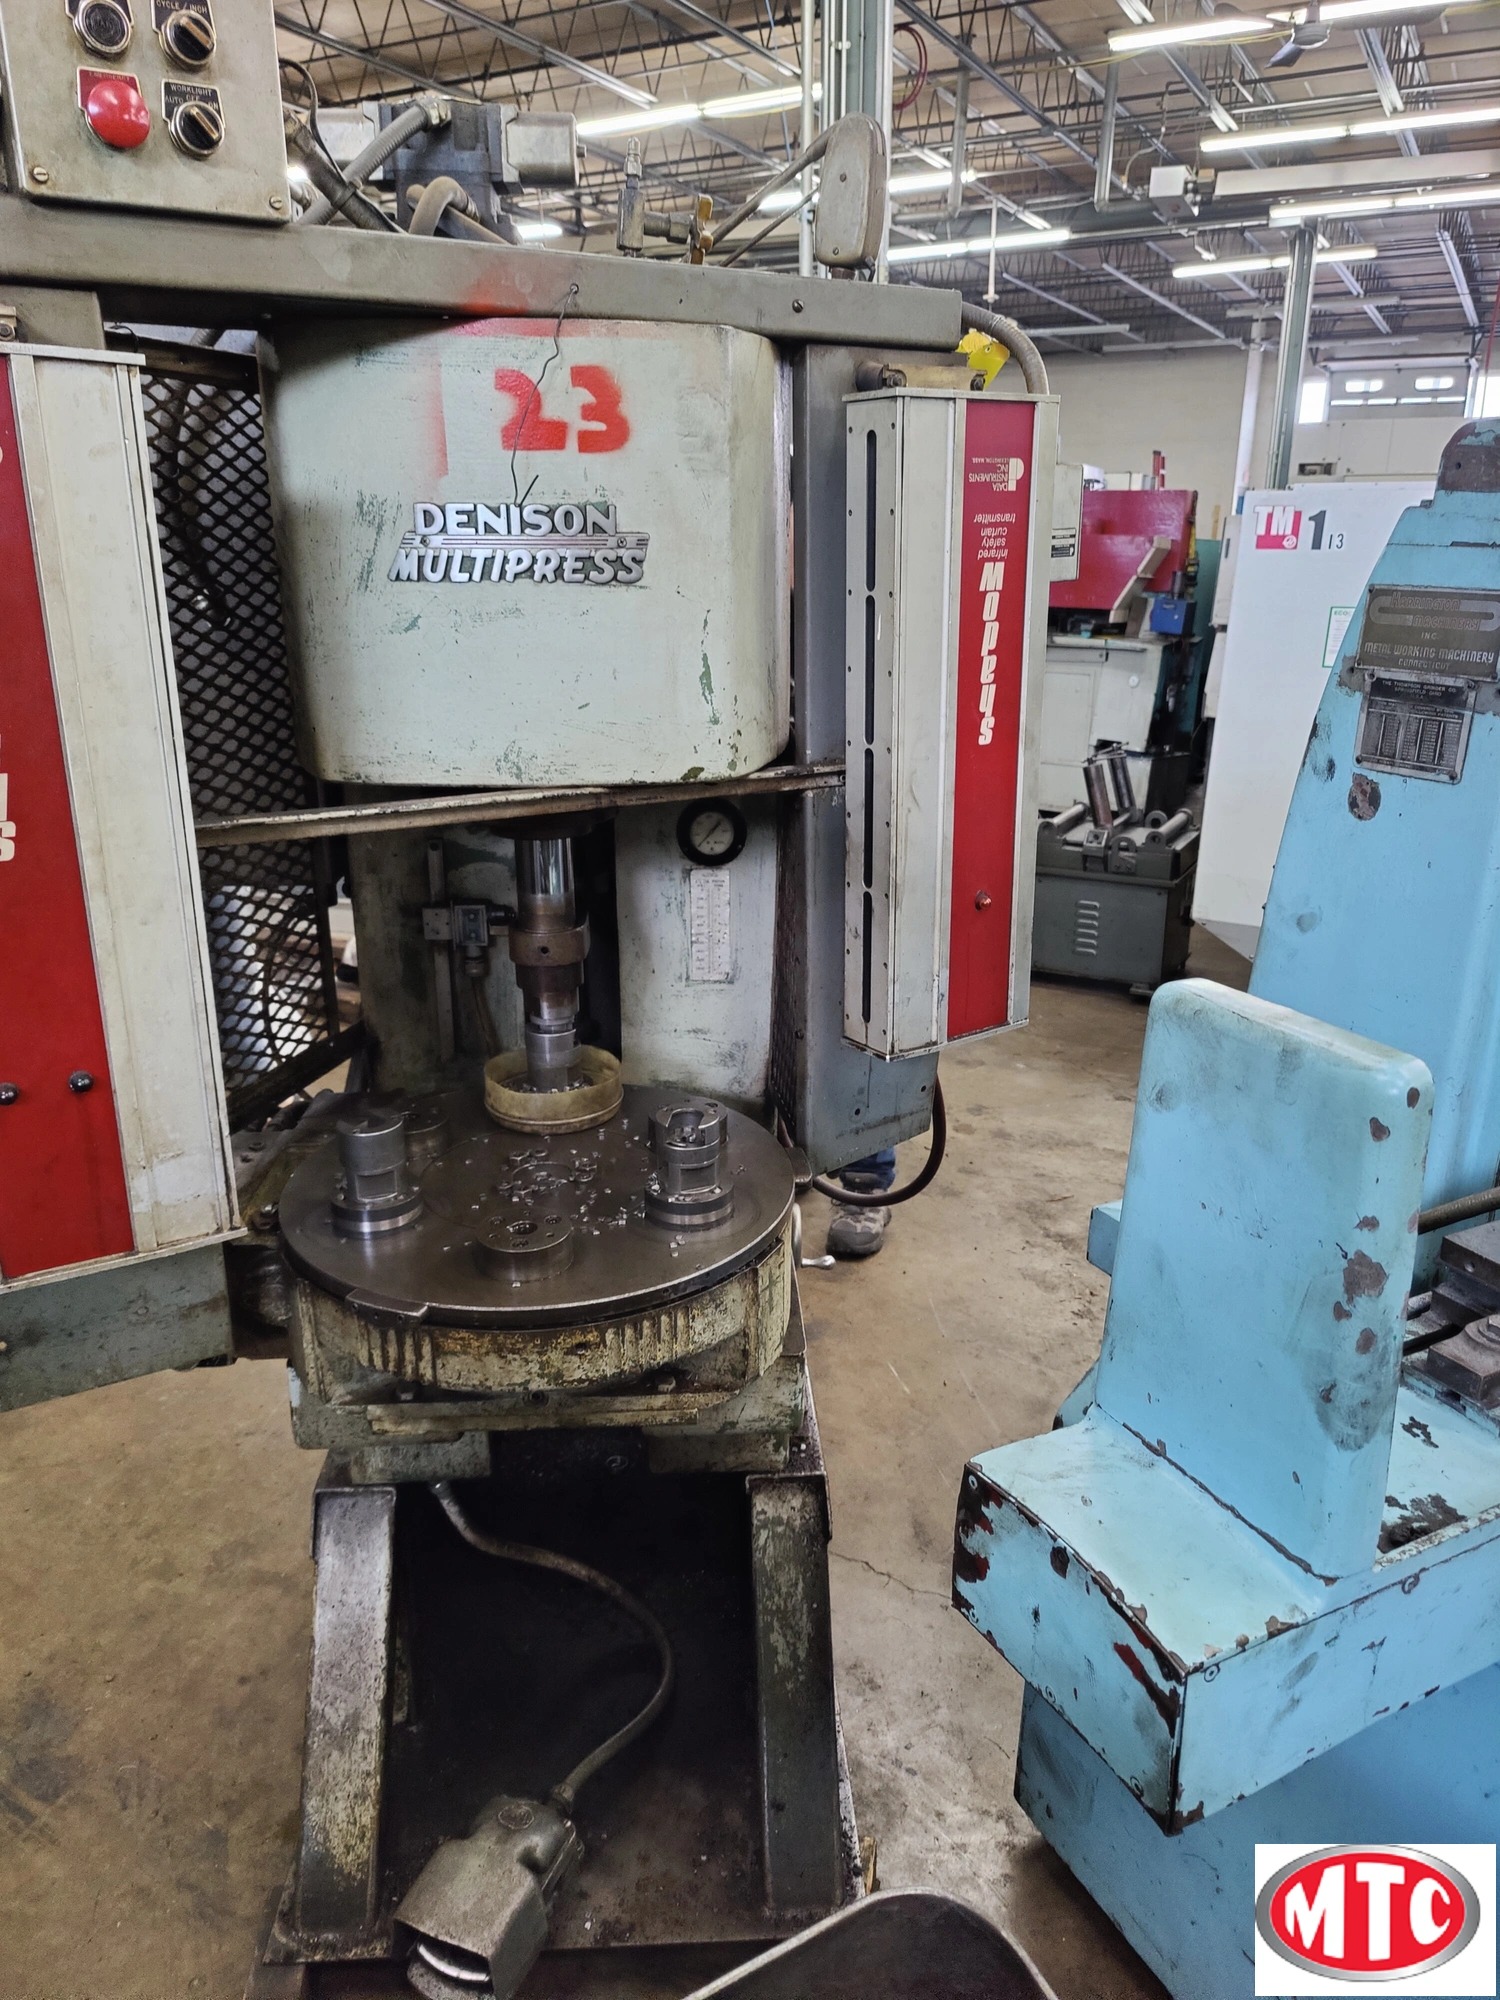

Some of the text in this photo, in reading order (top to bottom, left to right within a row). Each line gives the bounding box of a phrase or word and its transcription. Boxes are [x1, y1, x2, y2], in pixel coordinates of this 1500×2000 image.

[156, 0, 180, 10] CYCLE
[189, 4, 208, 14] INCH
[170, 84, 213, 96] WORKLIGHT
[165, 95, 184, 104] AUTO
[494, 365, 631, 453] 23
[968, 472, 1009, 483] INSTRUMENTS
[992, 482, 1008, 492] DATA
[413, 502, 617, 536] DENISON
[973, 513, 1016, 524] transmitter
[981, 527, 1008, 537] curtain
[1253, 505, 1296, 536] TM
[1308, 510, 1327, 550] 1
[981, 536, 1007, 547] safety
[977, 548, 1009, 560] infrared
[387, 548, 648, 584] MULTIPRESS
[1412, 615, 1480, 630] MACHINERY
[1364, 642, 1495, 664] METAL WORKING MACHINERY
[1398, 658, 1450, 670] CONNECTICUT
